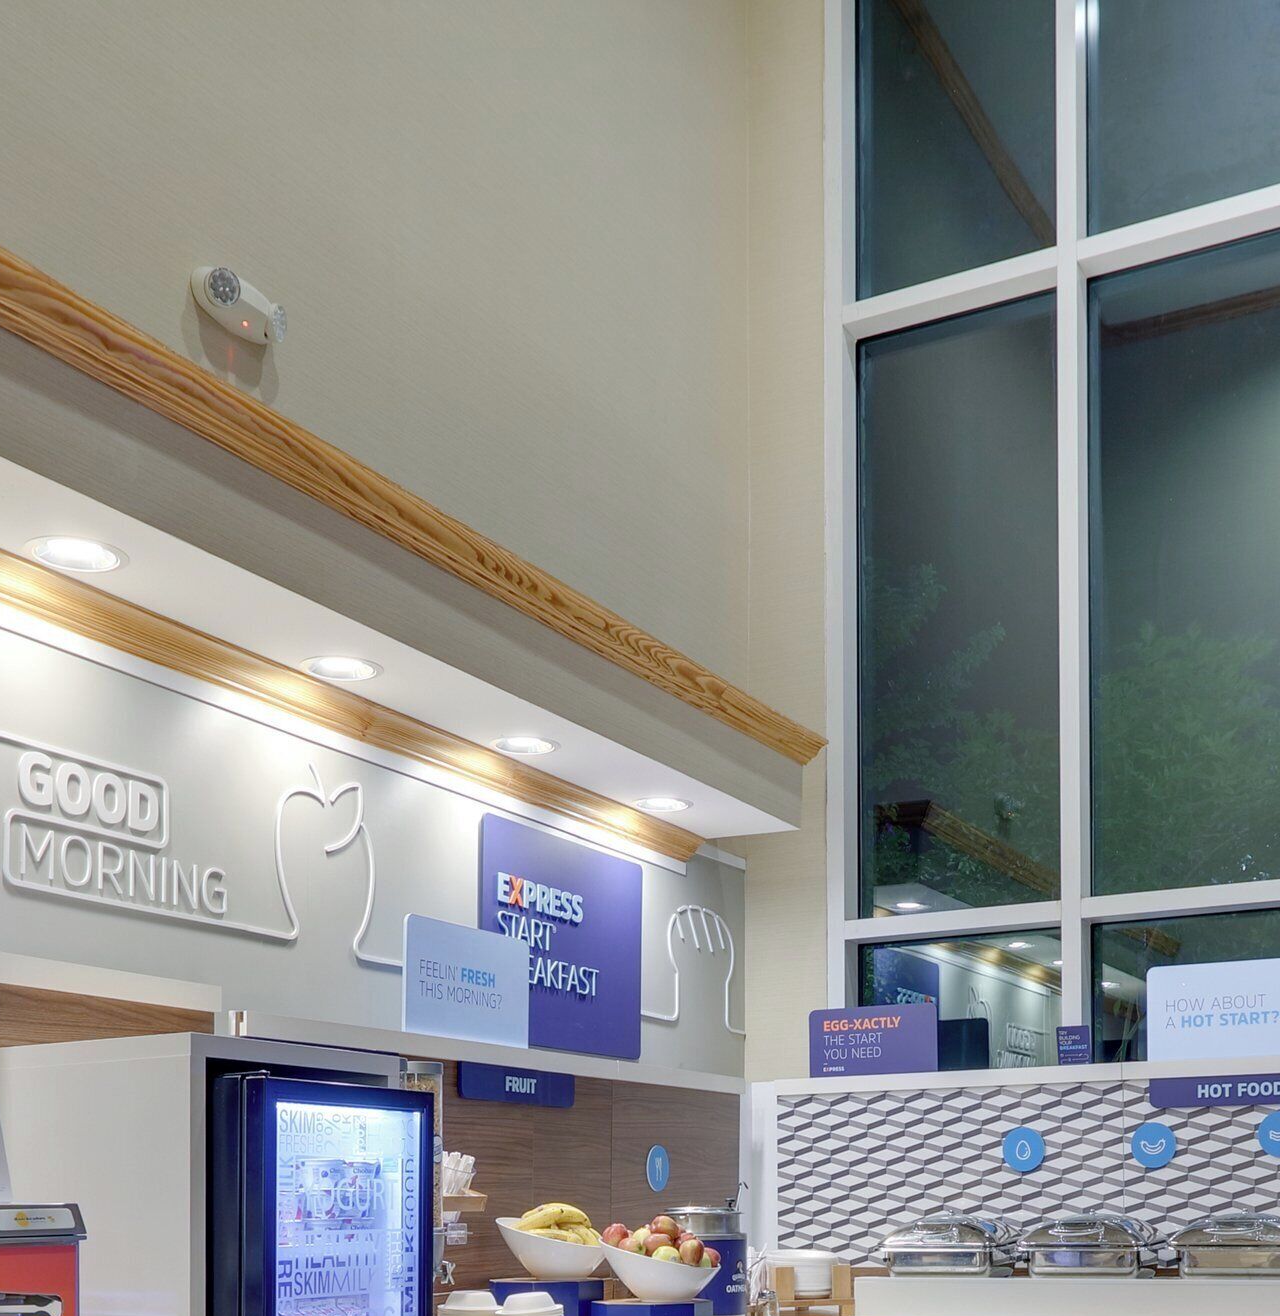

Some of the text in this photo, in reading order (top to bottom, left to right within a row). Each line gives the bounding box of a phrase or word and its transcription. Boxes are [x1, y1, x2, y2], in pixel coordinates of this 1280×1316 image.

[18, 751, 160, 832] GOOD
[20, 824, 228, 914] MORNING
[497, 871, 583, 923] EXPRESS
[461, 967, 495, 988] FRESH
[528, 955, 599, 996] EAKFAST
[420, 980, 502, 1010] THIS MORNING?
[1166, 993, 1266, 1012] HOW ABOUT
[823, 1016, 902, 1032] EGG-XACTLY
[1166, 1010, 1280, 1029] A HOT START?
[824, 1032, 882, 1046] THE START
[824, 1046, 882, 1060] YOU NEED
[505, 1075, 537, 1095] FRUIT
[1197, 1083, 1232, 1099] HOT
[279, 1134, 315, 1153] FRESH
